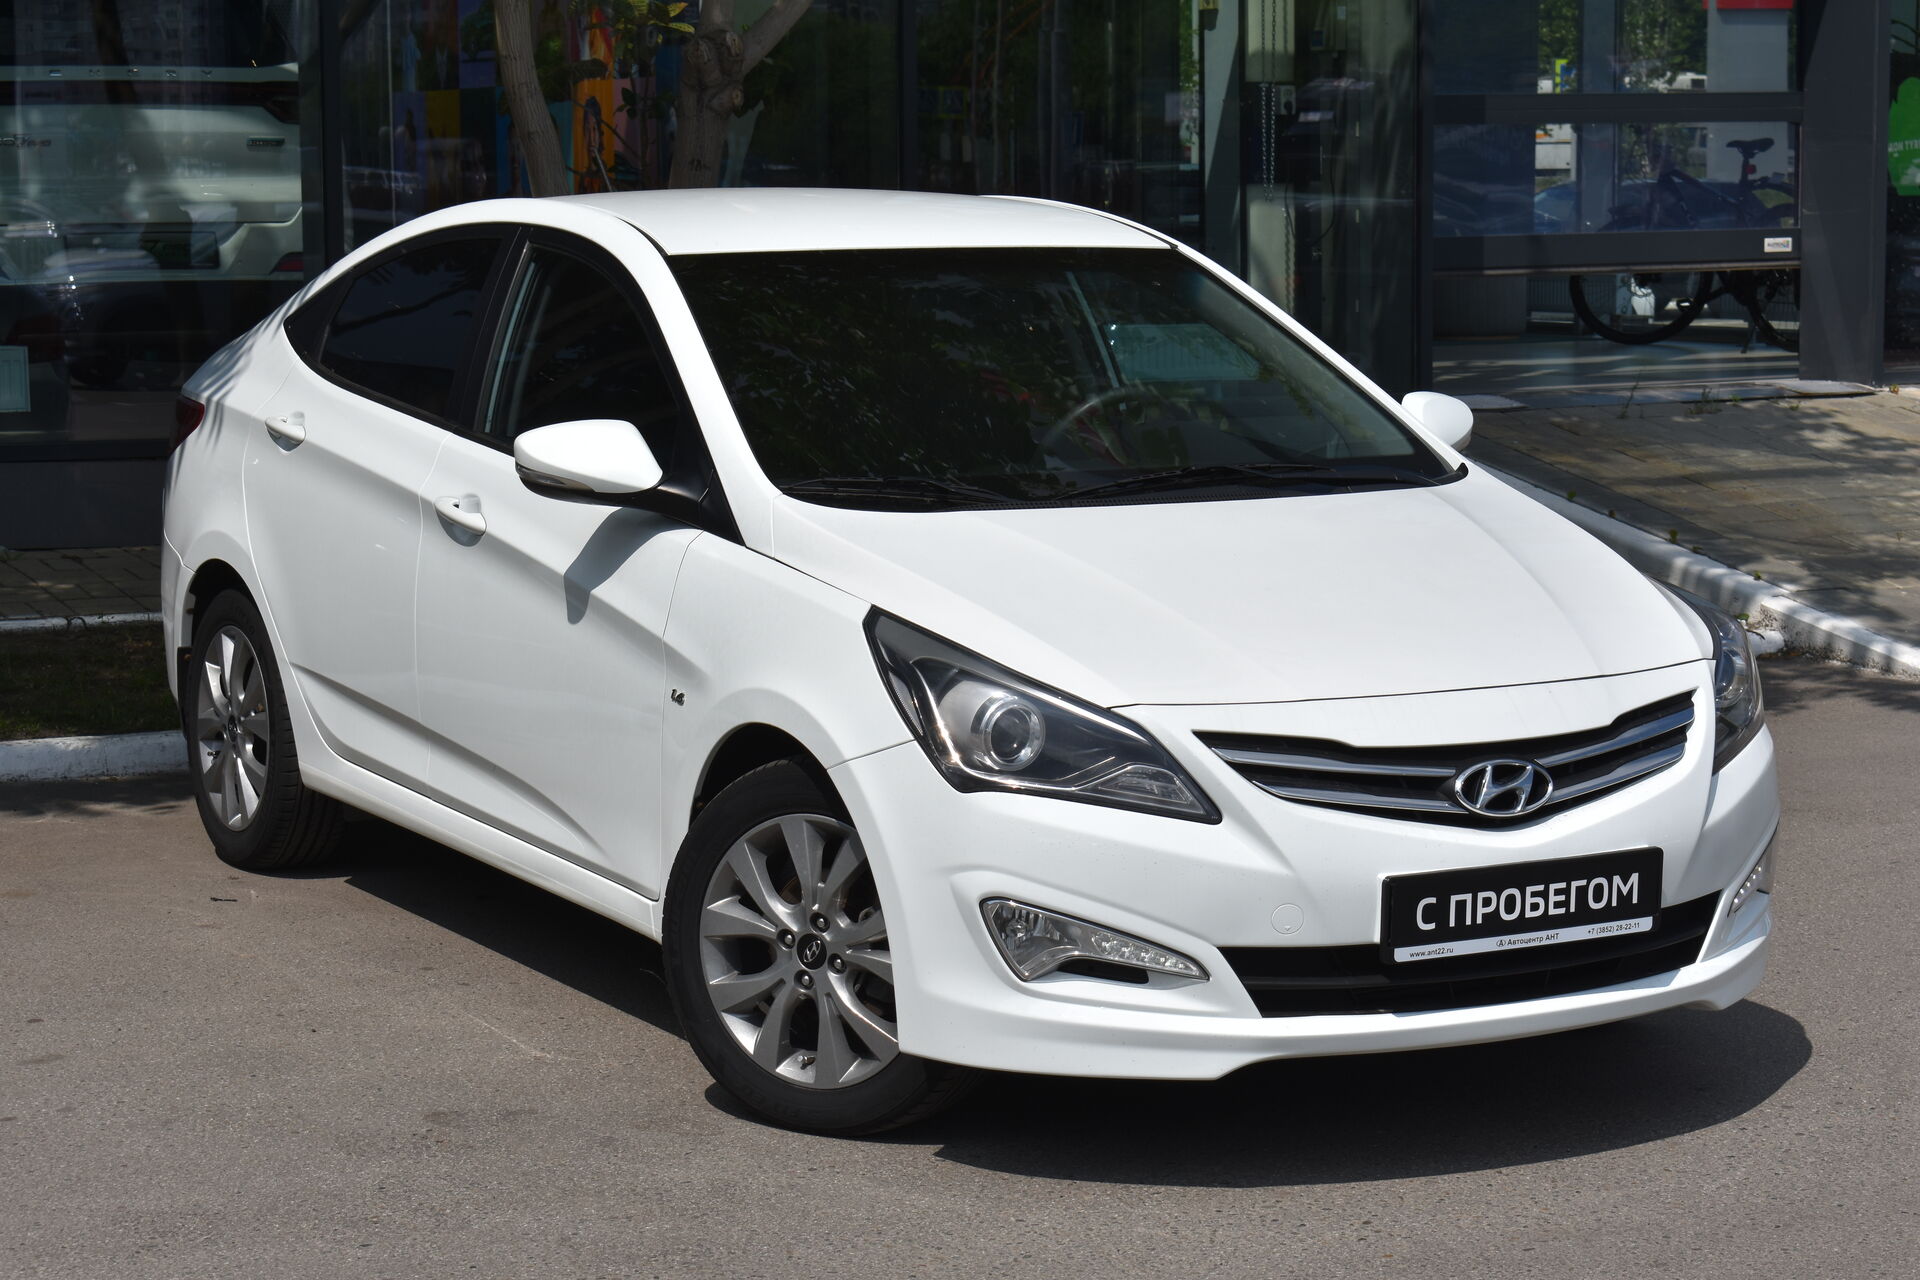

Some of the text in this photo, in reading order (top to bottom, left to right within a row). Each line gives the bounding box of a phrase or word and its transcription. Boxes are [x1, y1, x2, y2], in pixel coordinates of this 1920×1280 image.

[1416, 872, 1639, 931] С ПРОБЕГОМ
[1587, 922, 1640, 936] +7 (3852) 28-22-11
[1507, 932, 1560, 946] Автоцентр АНТ
[1409, 947, 1454, 958] www.ant22.ru
